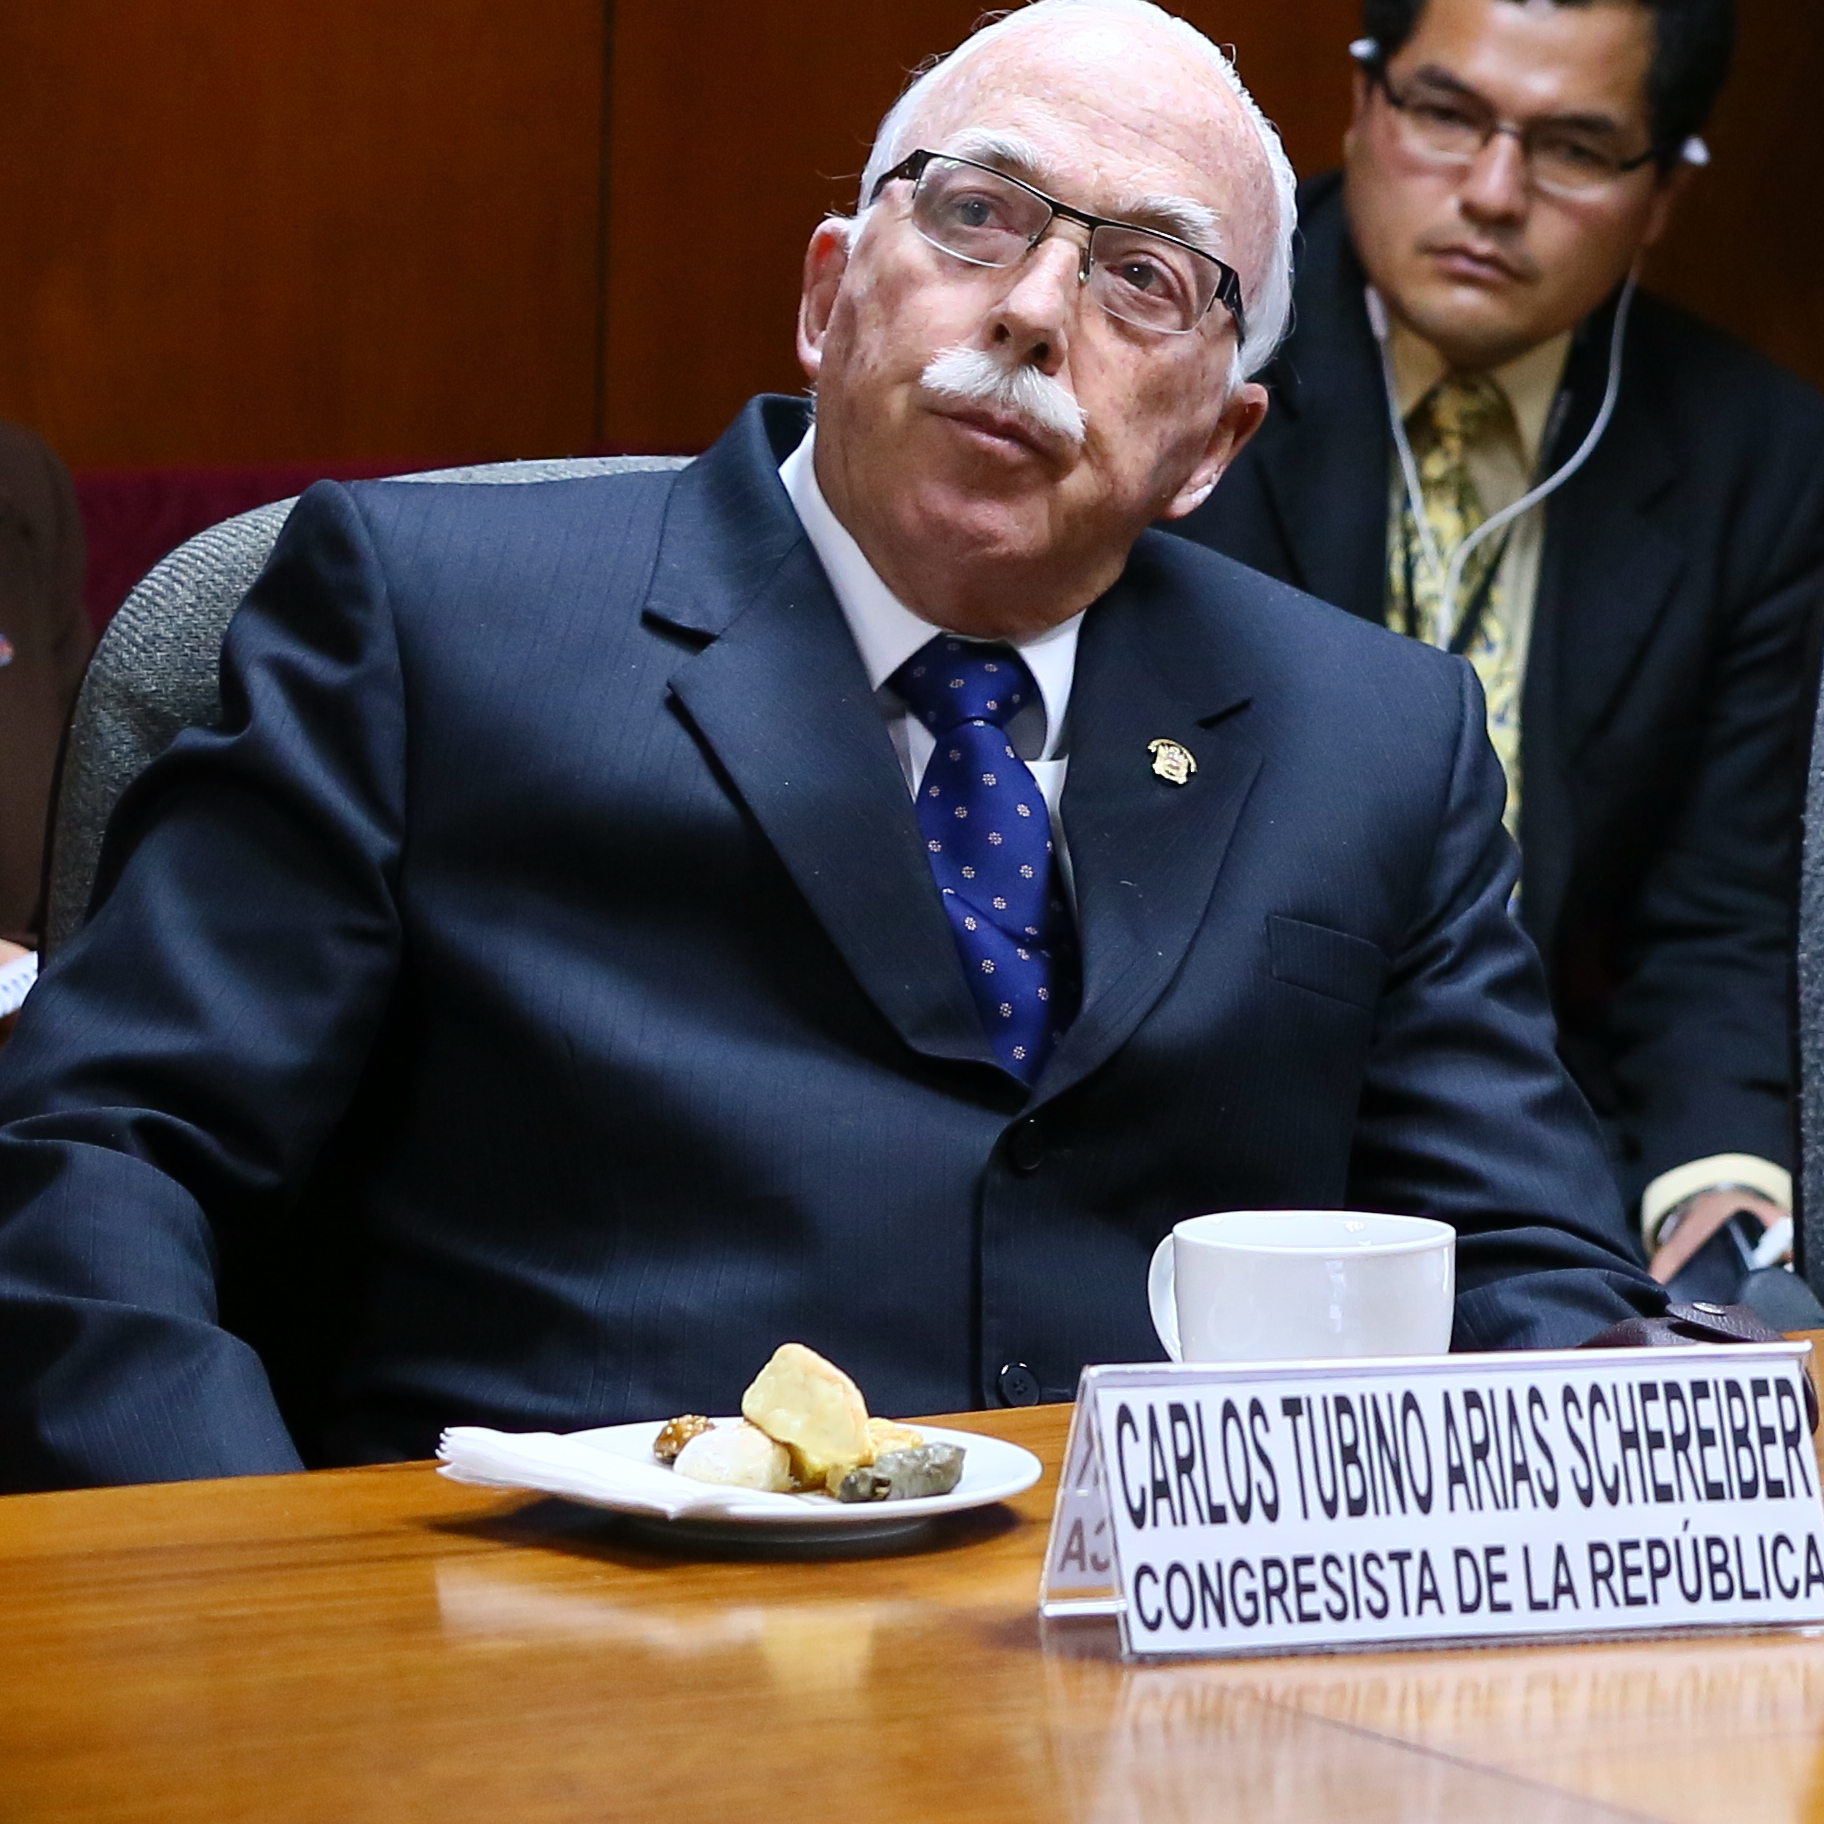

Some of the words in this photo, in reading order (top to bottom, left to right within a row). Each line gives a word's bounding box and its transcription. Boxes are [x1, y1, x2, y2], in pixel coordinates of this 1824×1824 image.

[1117, 1398, 1278, 1529] CARLOS
[1282, 1391, 1432, 1519] TUBINO
[1444, 1386, 1558, 1511] ARIAS
[1563, 1379, 1812, 1507] SCHEREIBER
[1135, 1551, 1444, 1631] CONGRESISTA
[1454, 1547, 1512, 1613] DE
[1525, 1545, 1578, 1610] LA
